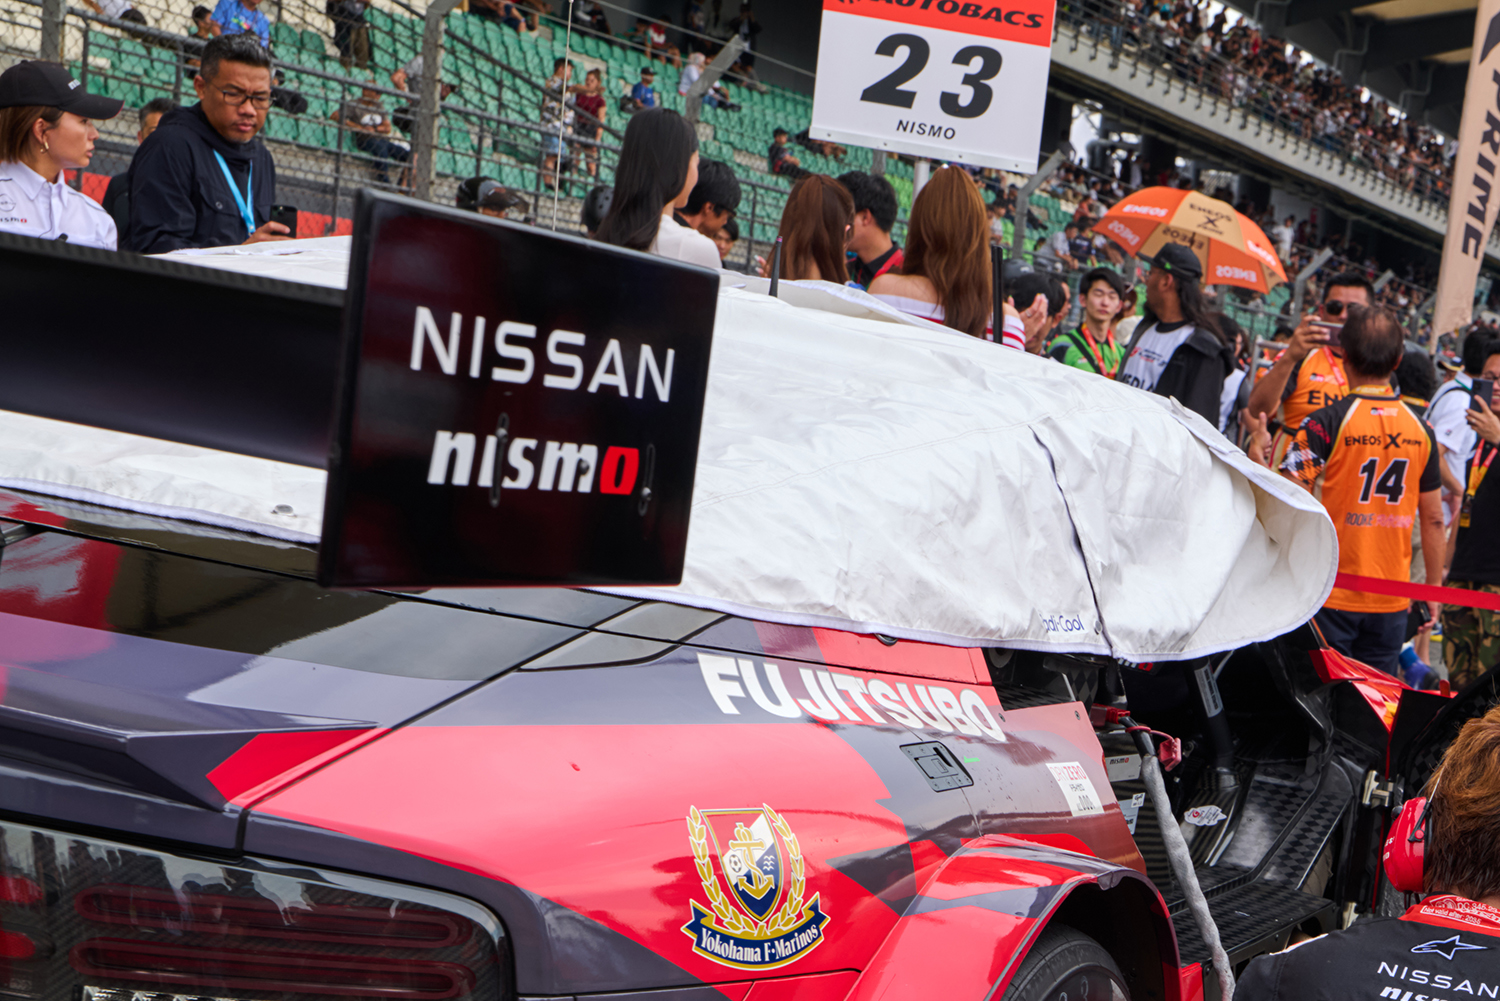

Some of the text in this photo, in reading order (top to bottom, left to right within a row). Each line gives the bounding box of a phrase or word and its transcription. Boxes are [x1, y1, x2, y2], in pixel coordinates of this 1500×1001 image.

[860, 33, 1003, 119] 23
[897, 120, 956, 140] NISMO
[1123, 204, 1168, 217] ENEOS
[410, 306, 675, 402] NISSAN
[427, 429, 639, 496] nismo
[1345, 435, 1381, 447] ENEOS
[1358, 457, 1410, 505] 14
[697, 652, 1006, 743] FUJITSUBO
[700, 928, 762, 962] Yokohama
[1377, 961, 1500, 1000] NISSAN
